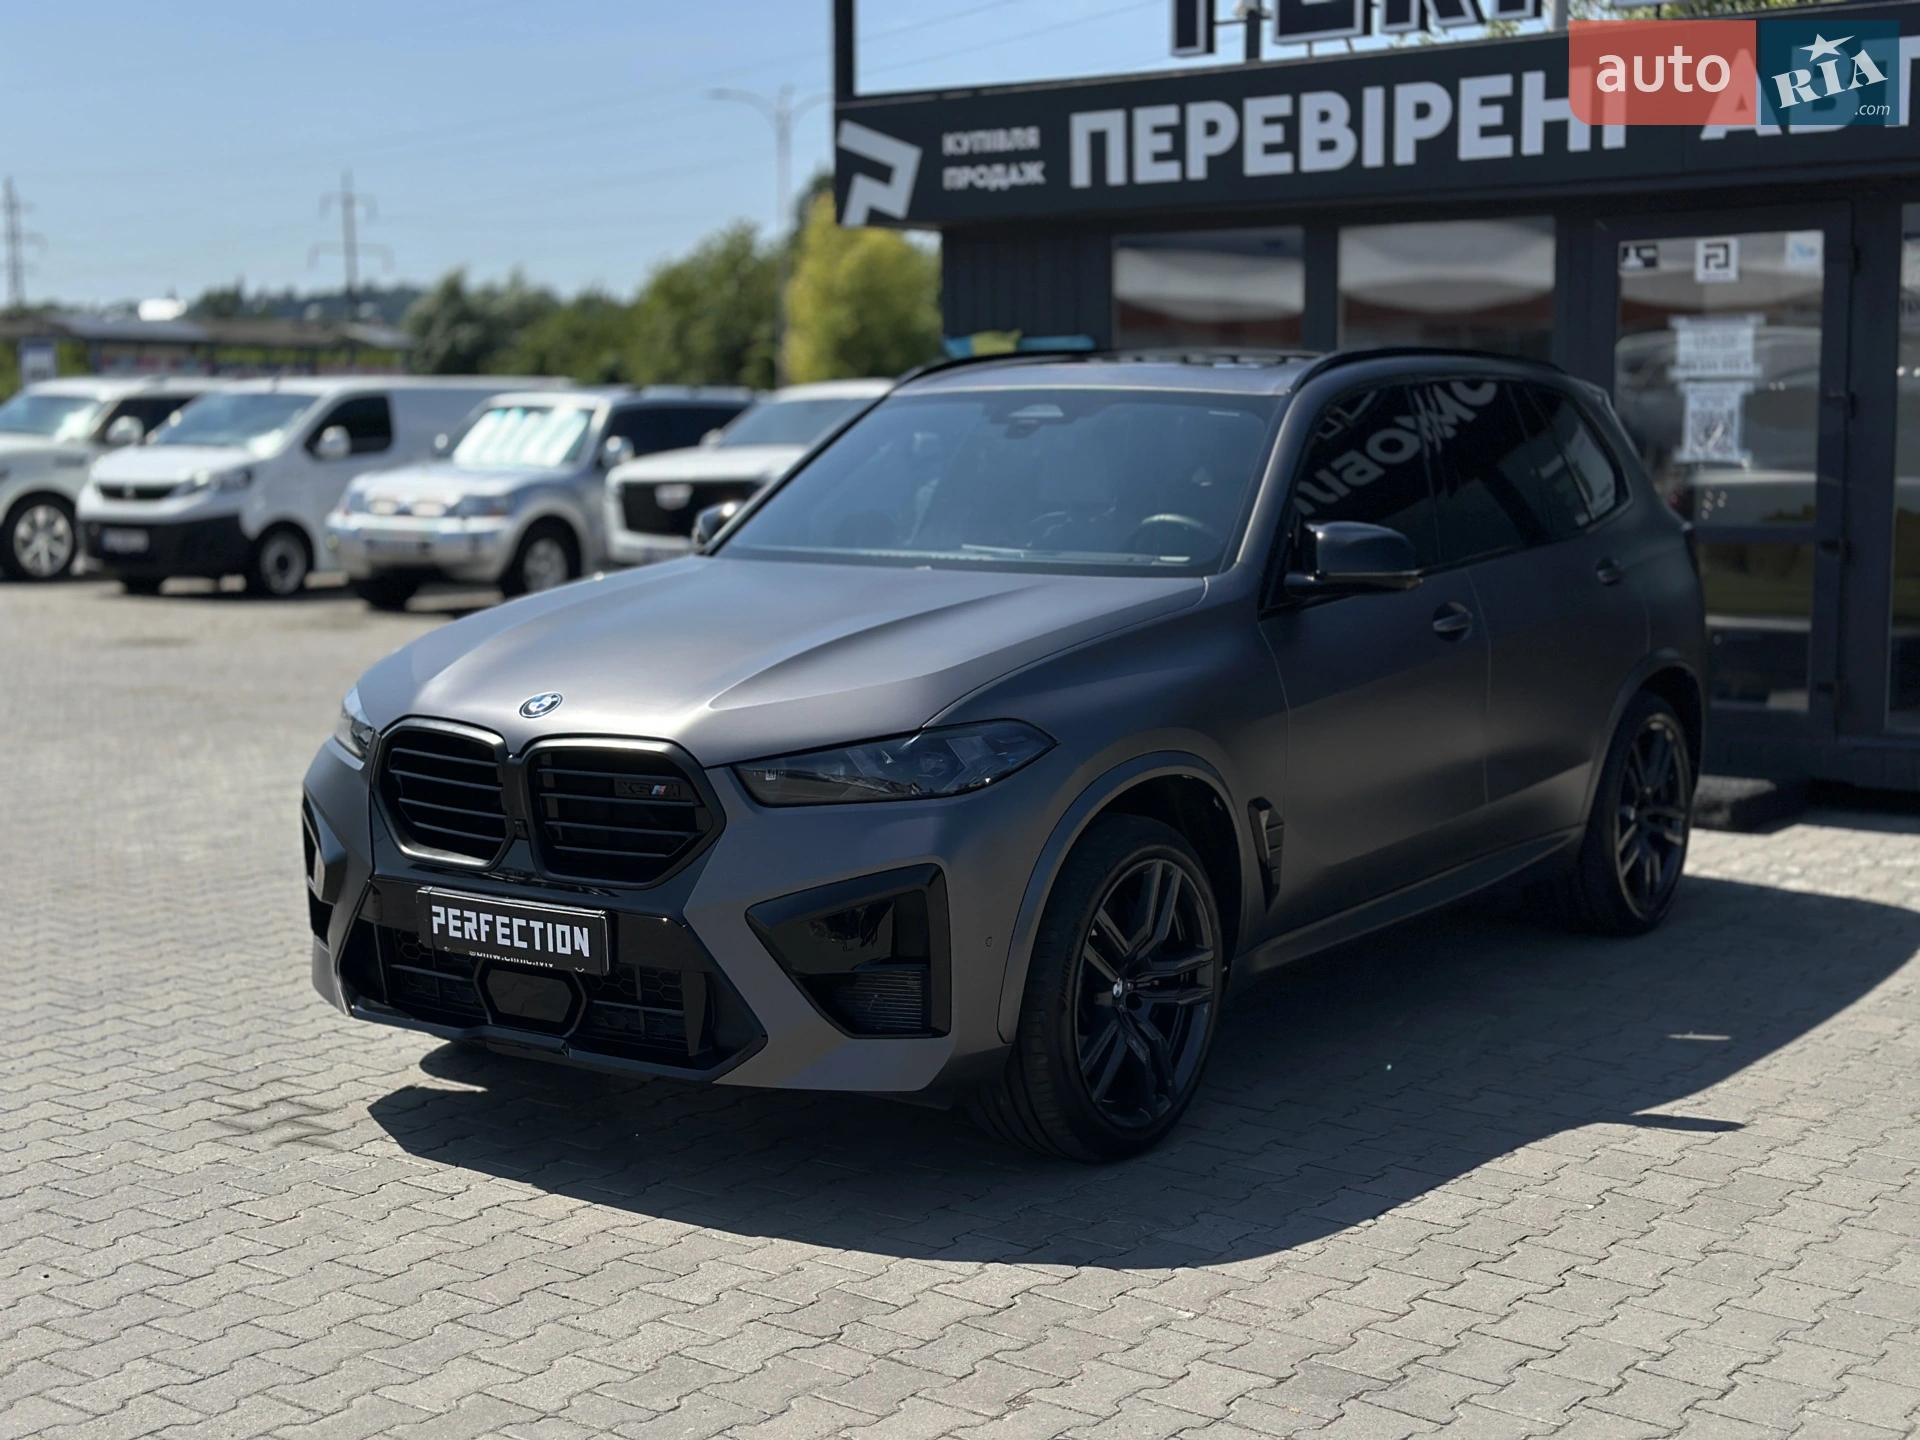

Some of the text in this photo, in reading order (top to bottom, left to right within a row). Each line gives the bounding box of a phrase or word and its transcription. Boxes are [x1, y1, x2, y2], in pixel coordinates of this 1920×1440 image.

[1070, 63, 1627, 188] ПЕРЕВІРЕНІ
[943, 161, 1047, 191] ПРОДАЖ
[432, 905, 590, 957] PERFECTION
